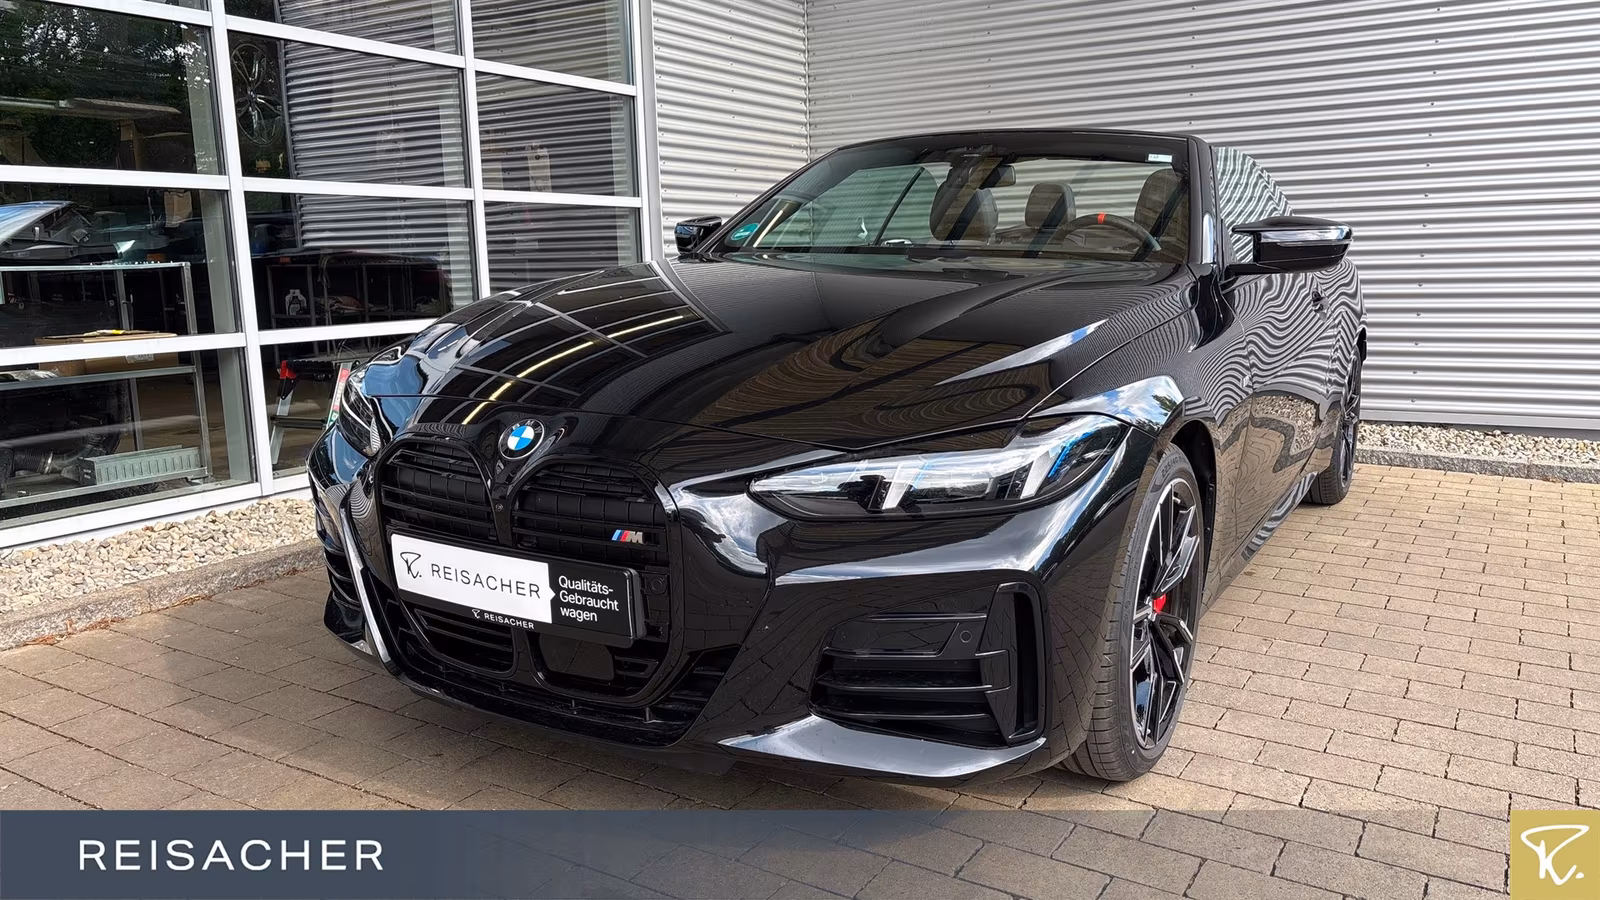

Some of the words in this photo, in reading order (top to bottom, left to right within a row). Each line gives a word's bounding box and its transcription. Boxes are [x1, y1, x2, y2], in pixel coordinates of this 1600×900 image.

[431, 563, 541, 599] REISACHER
[558, 575, 614, 595] Qualitäts-
[559, 590, 620, 612] Gebraucht
[483, 612, 535, 630] REISACHER
[560, 606, 598, 622] wagen
